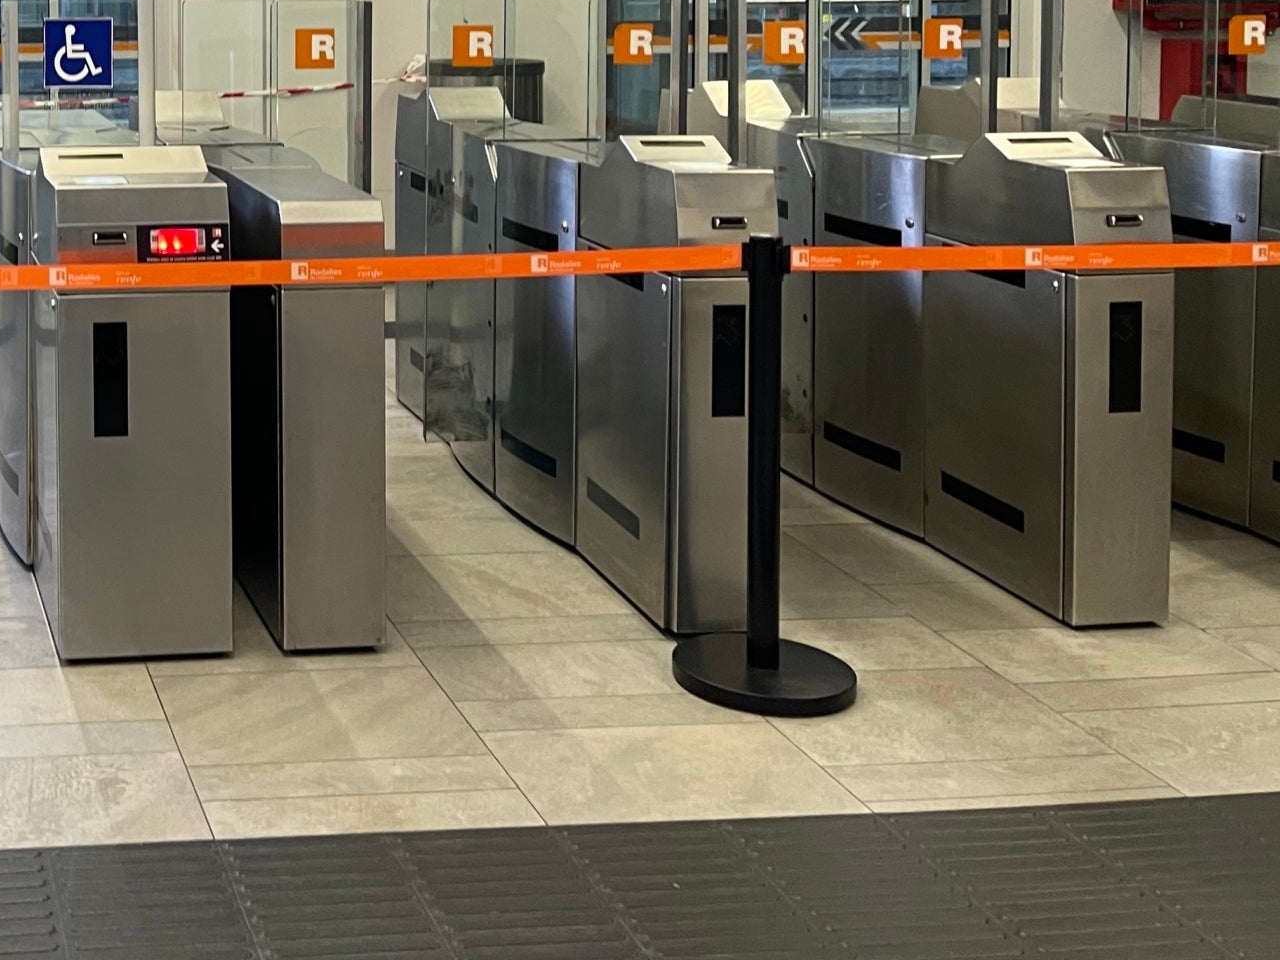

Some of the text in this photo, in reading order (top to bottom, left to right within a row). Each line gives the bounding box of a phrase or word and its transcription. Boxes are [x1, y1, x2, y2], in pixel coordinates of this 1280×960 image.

[470, 31, 492, 57] R
[630, 29, 652, 55] R
[780, 27, 804, 54] R
[939, 24, 962, 49] R
[1244, 20, 1266, 45] R
[312, 34, 333, 60] R
